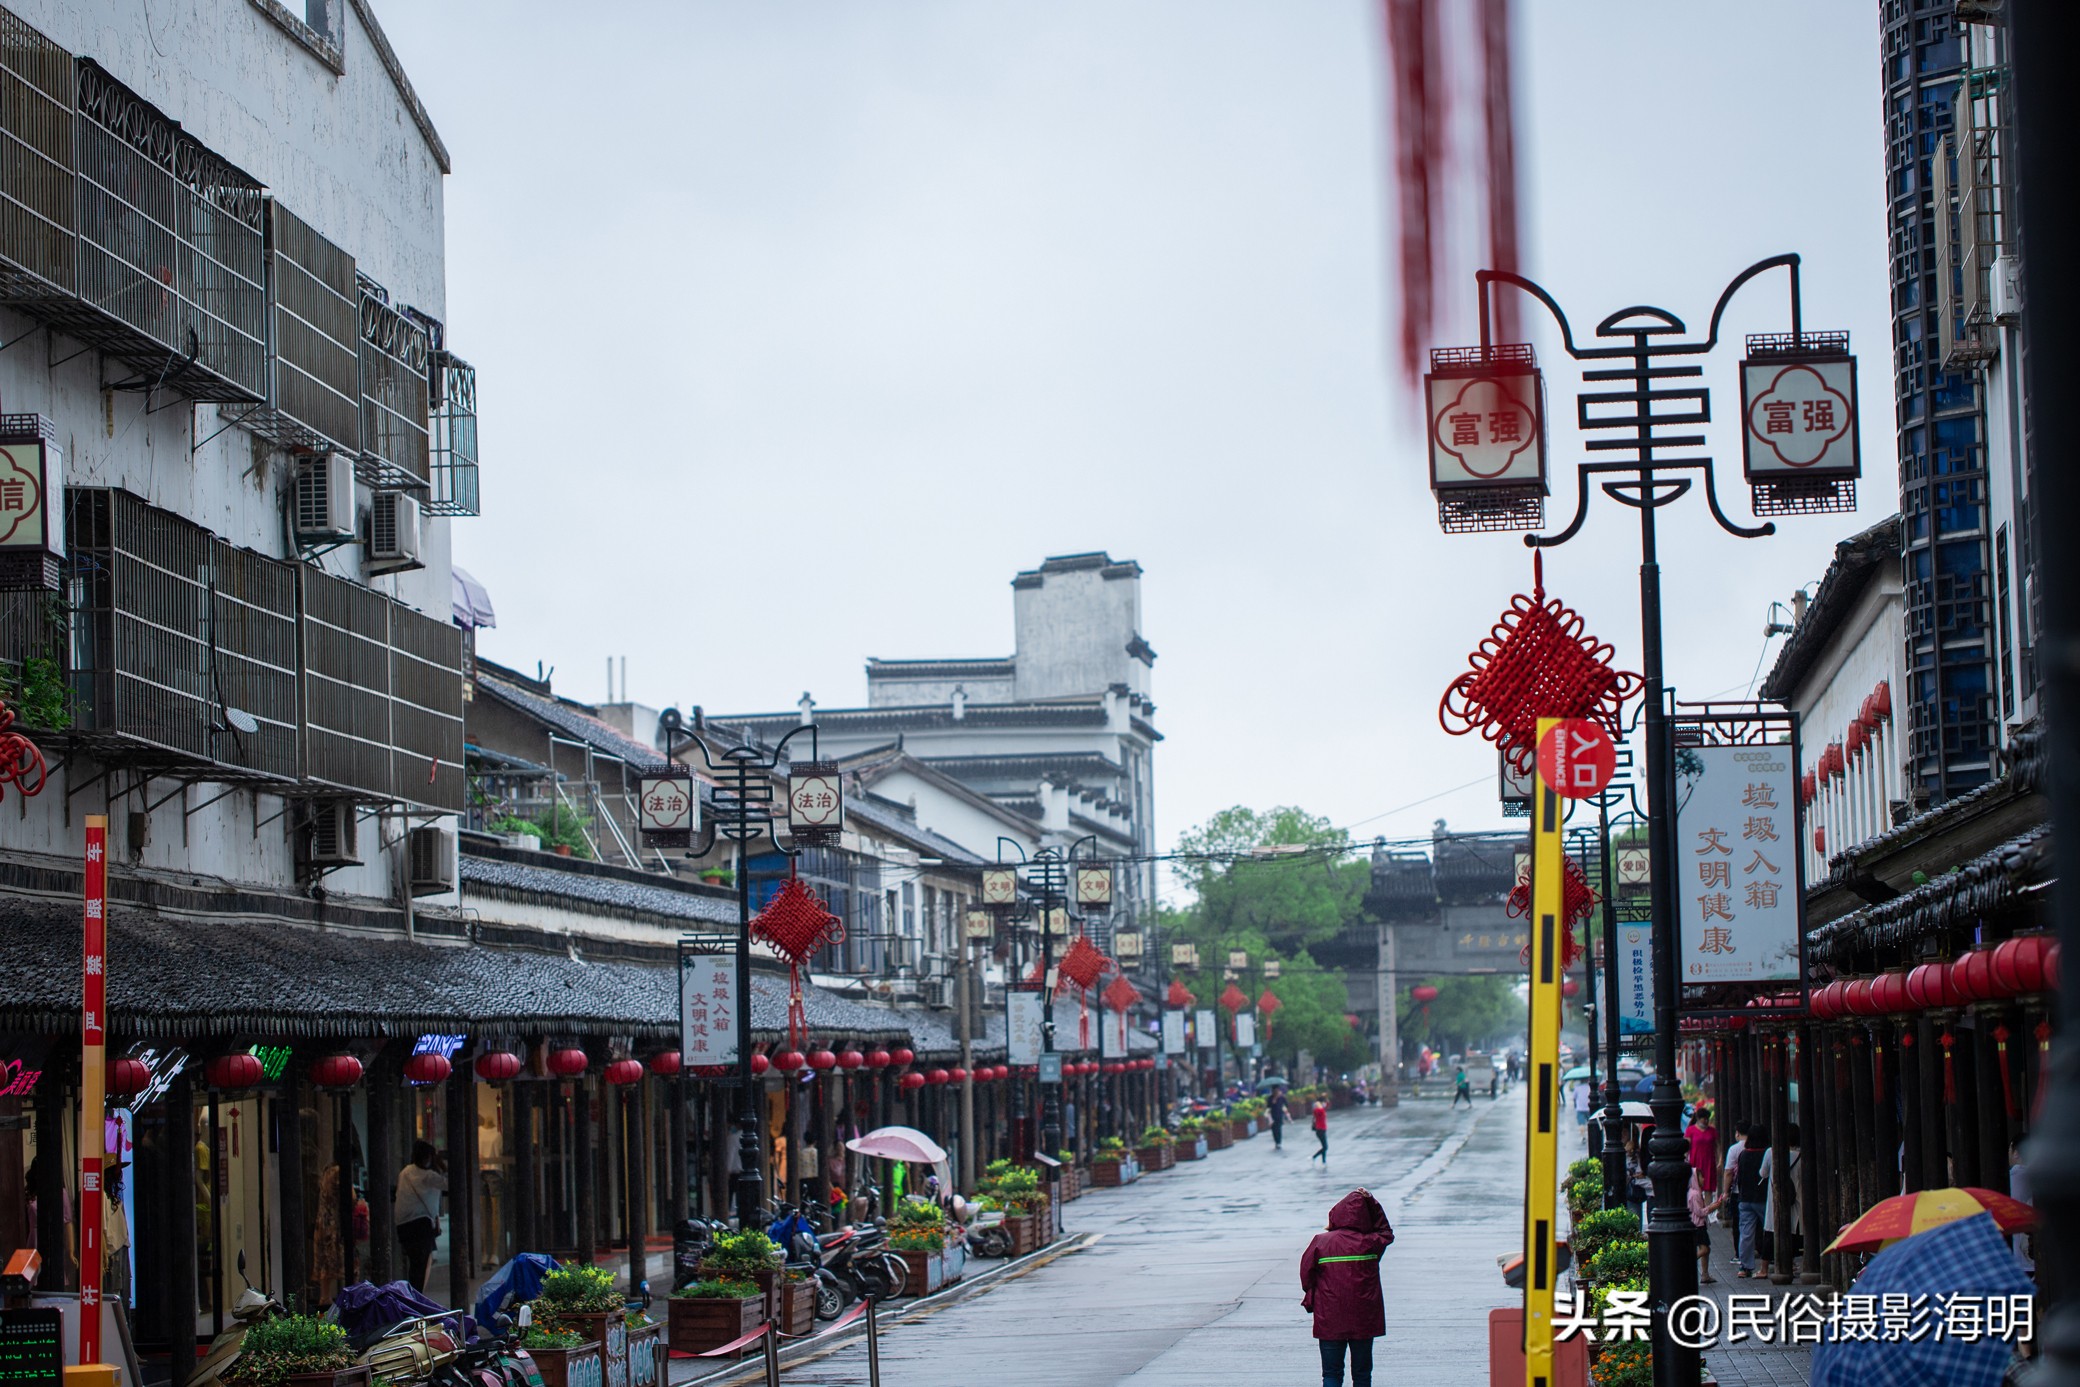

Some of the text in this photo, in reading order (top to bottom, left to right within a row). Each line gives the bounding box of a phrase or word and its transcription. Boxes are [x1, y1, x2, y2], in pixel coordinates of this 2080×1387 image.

[1449, 411, 1524, 447] 富强
[1762, 399, 1837, 434] 富强
[1554, 728, 1567, 787] ENTRANCE
[1570, 730, 1600, 787] 入口
[648, 795, 683, 812] 法治
[798, 791, 832, 809] 法治
[1741, 782, 1783, 910] 垃圾入箱
[989, 881, 1011, 892] 文明
[1084, 880, 1106, 891] 文明
[1695, 826, 1737, 955] 文明健康
[86, 842, 103, 1031] 严禁跟车
[712, 971, 731, 1032] 垃圾入箱
[1632, 949, 1645, 1018] 积极检举黑恶势力
[690, 992, 709, 1053] 文明健康
[82, 1171, 100, 1362] 一杆一闸
